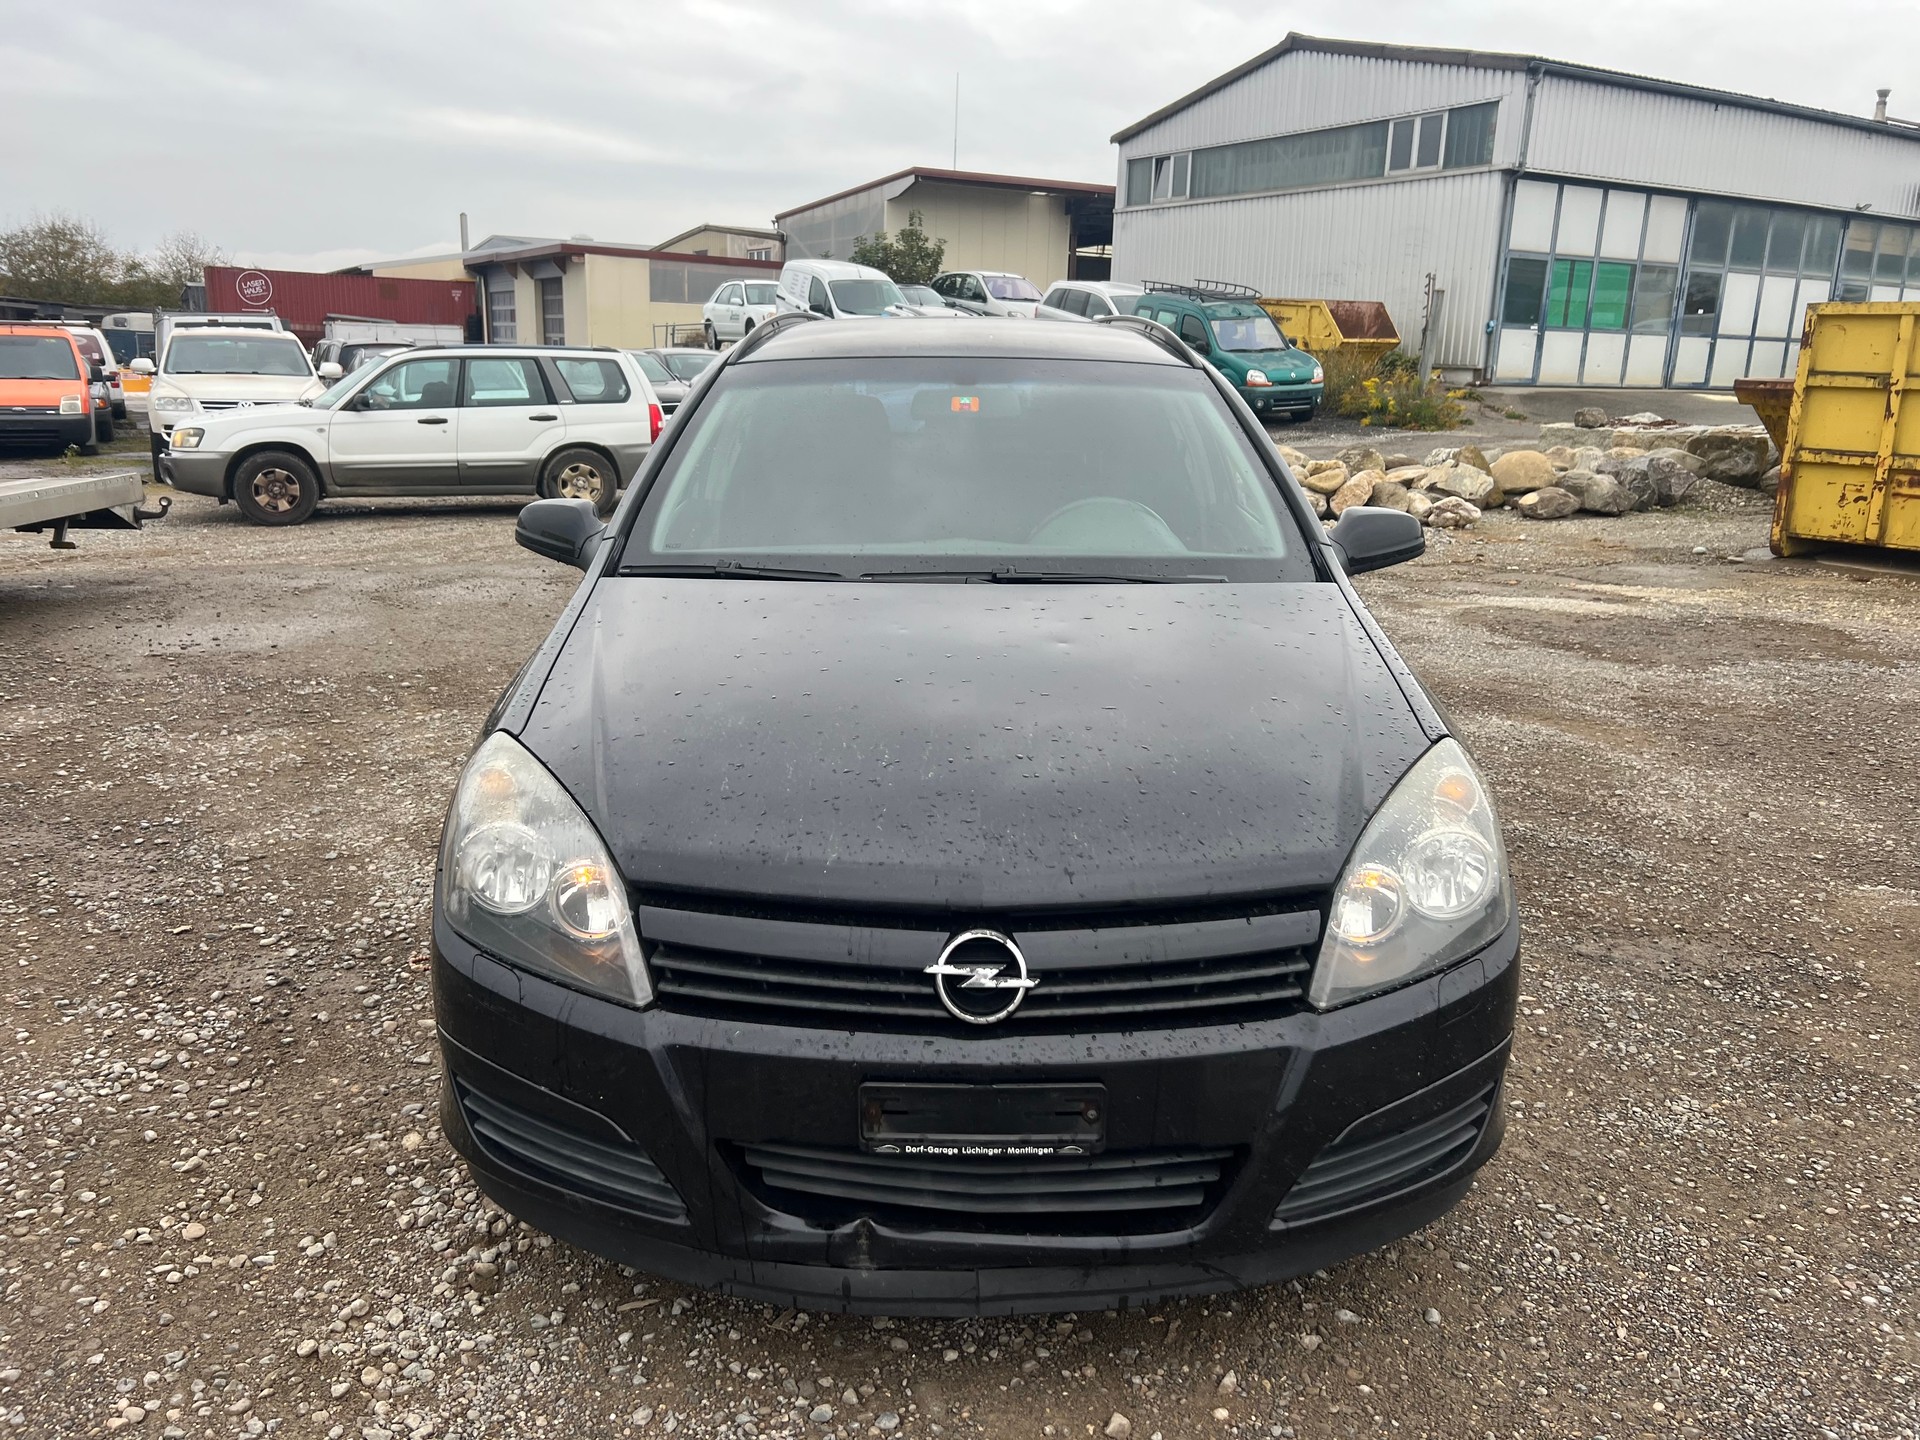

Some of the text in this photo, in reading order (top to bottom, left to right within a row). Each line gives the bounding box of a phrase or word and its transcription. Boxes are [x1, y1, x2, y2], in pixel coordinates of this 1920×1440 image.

[242, 280, 265, 288] LASER
[905, 1145, 1053, 1155] Dorf-Garage Lüchinger Montlingen
